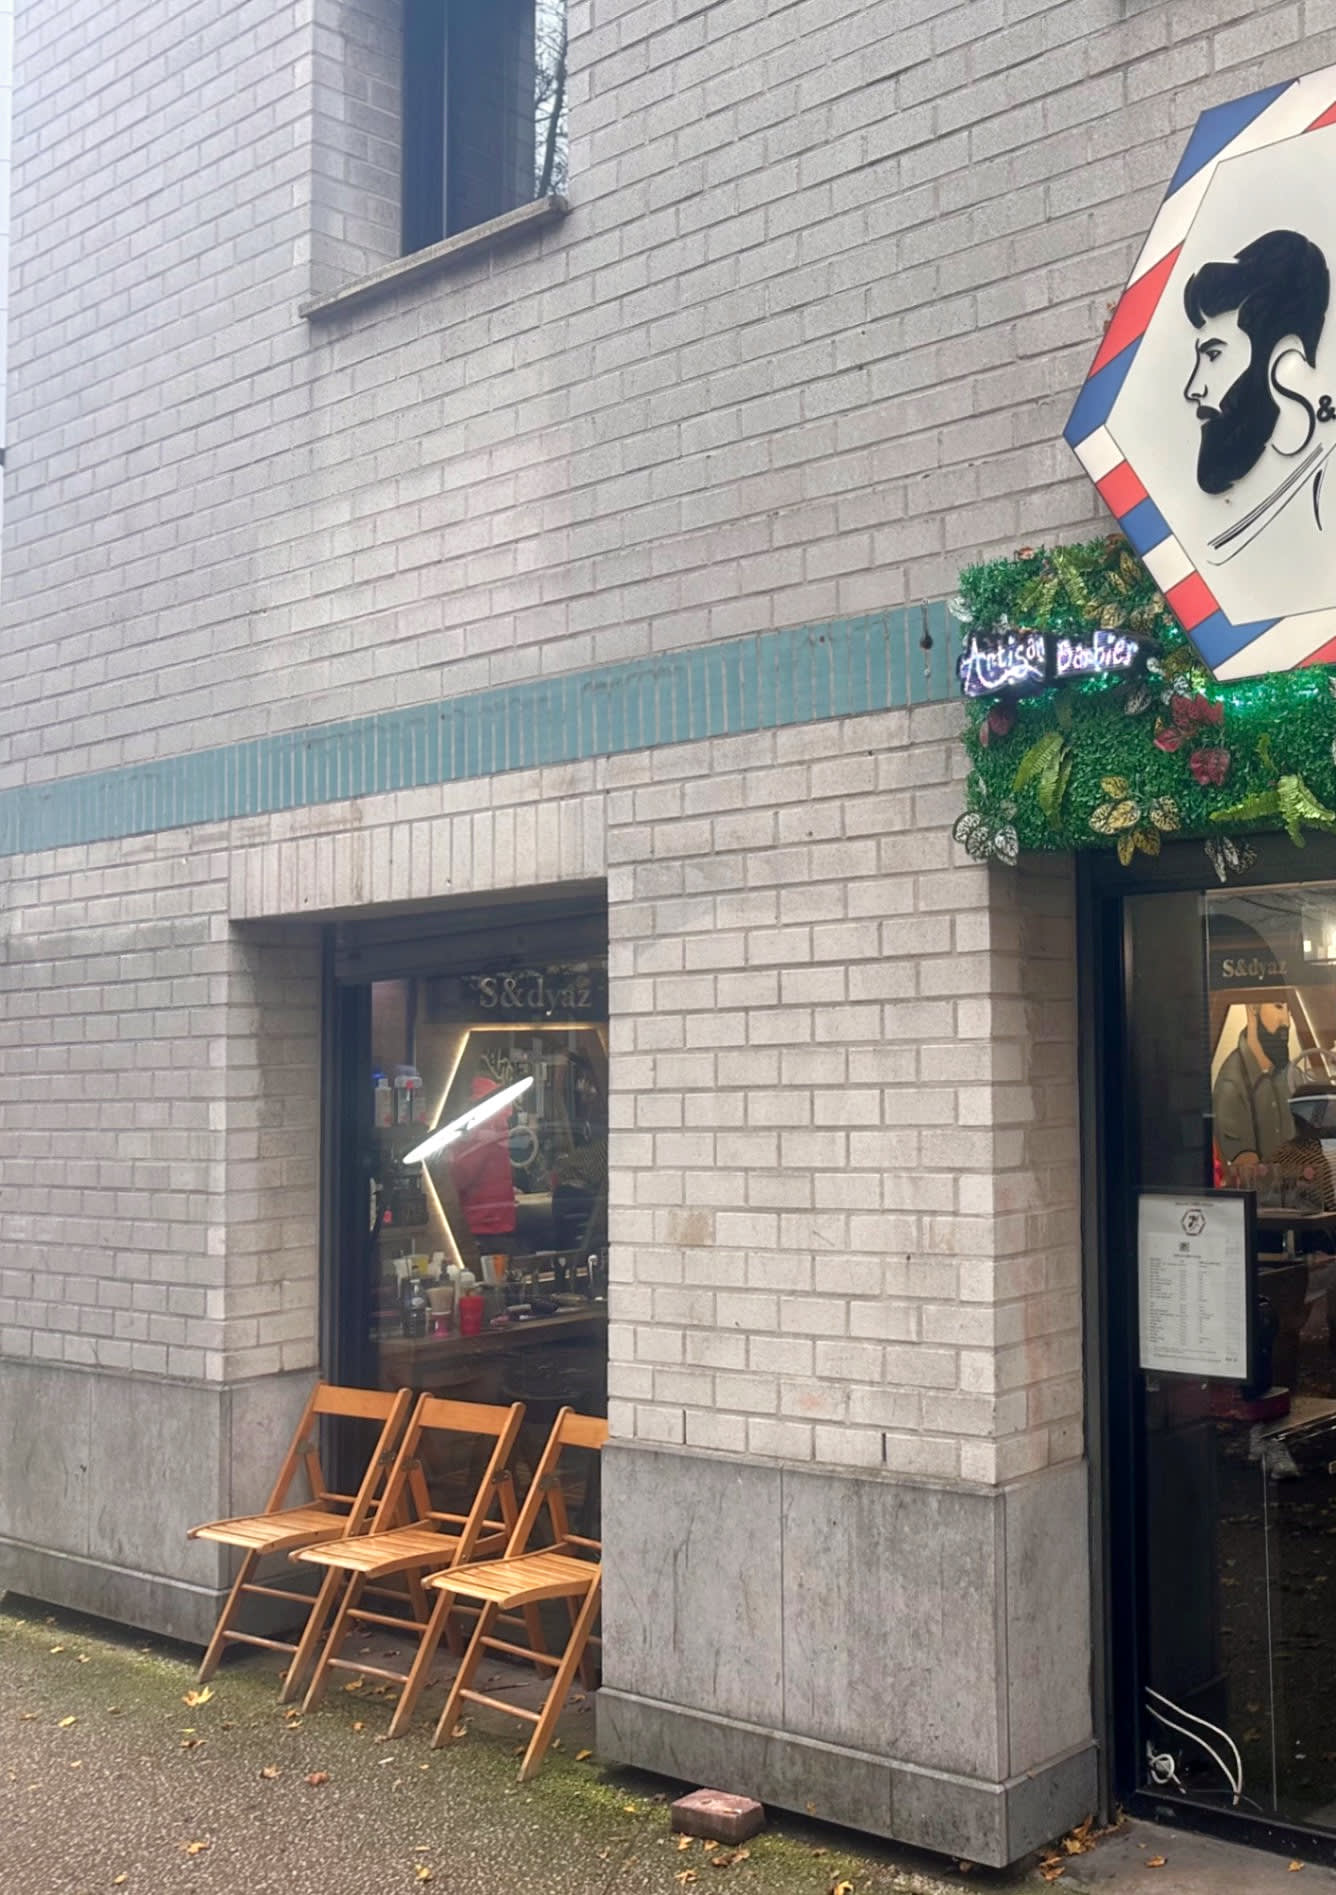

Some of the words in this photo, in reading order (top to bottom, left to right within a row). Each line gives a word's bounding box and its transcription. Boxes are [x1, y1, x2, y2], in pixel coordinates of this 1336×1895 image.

[960, 635, 1046, 695] Artisan
[1056, 631, 1139, 675] Barbier
[480, 977, 593, 1016] S&dyaz
